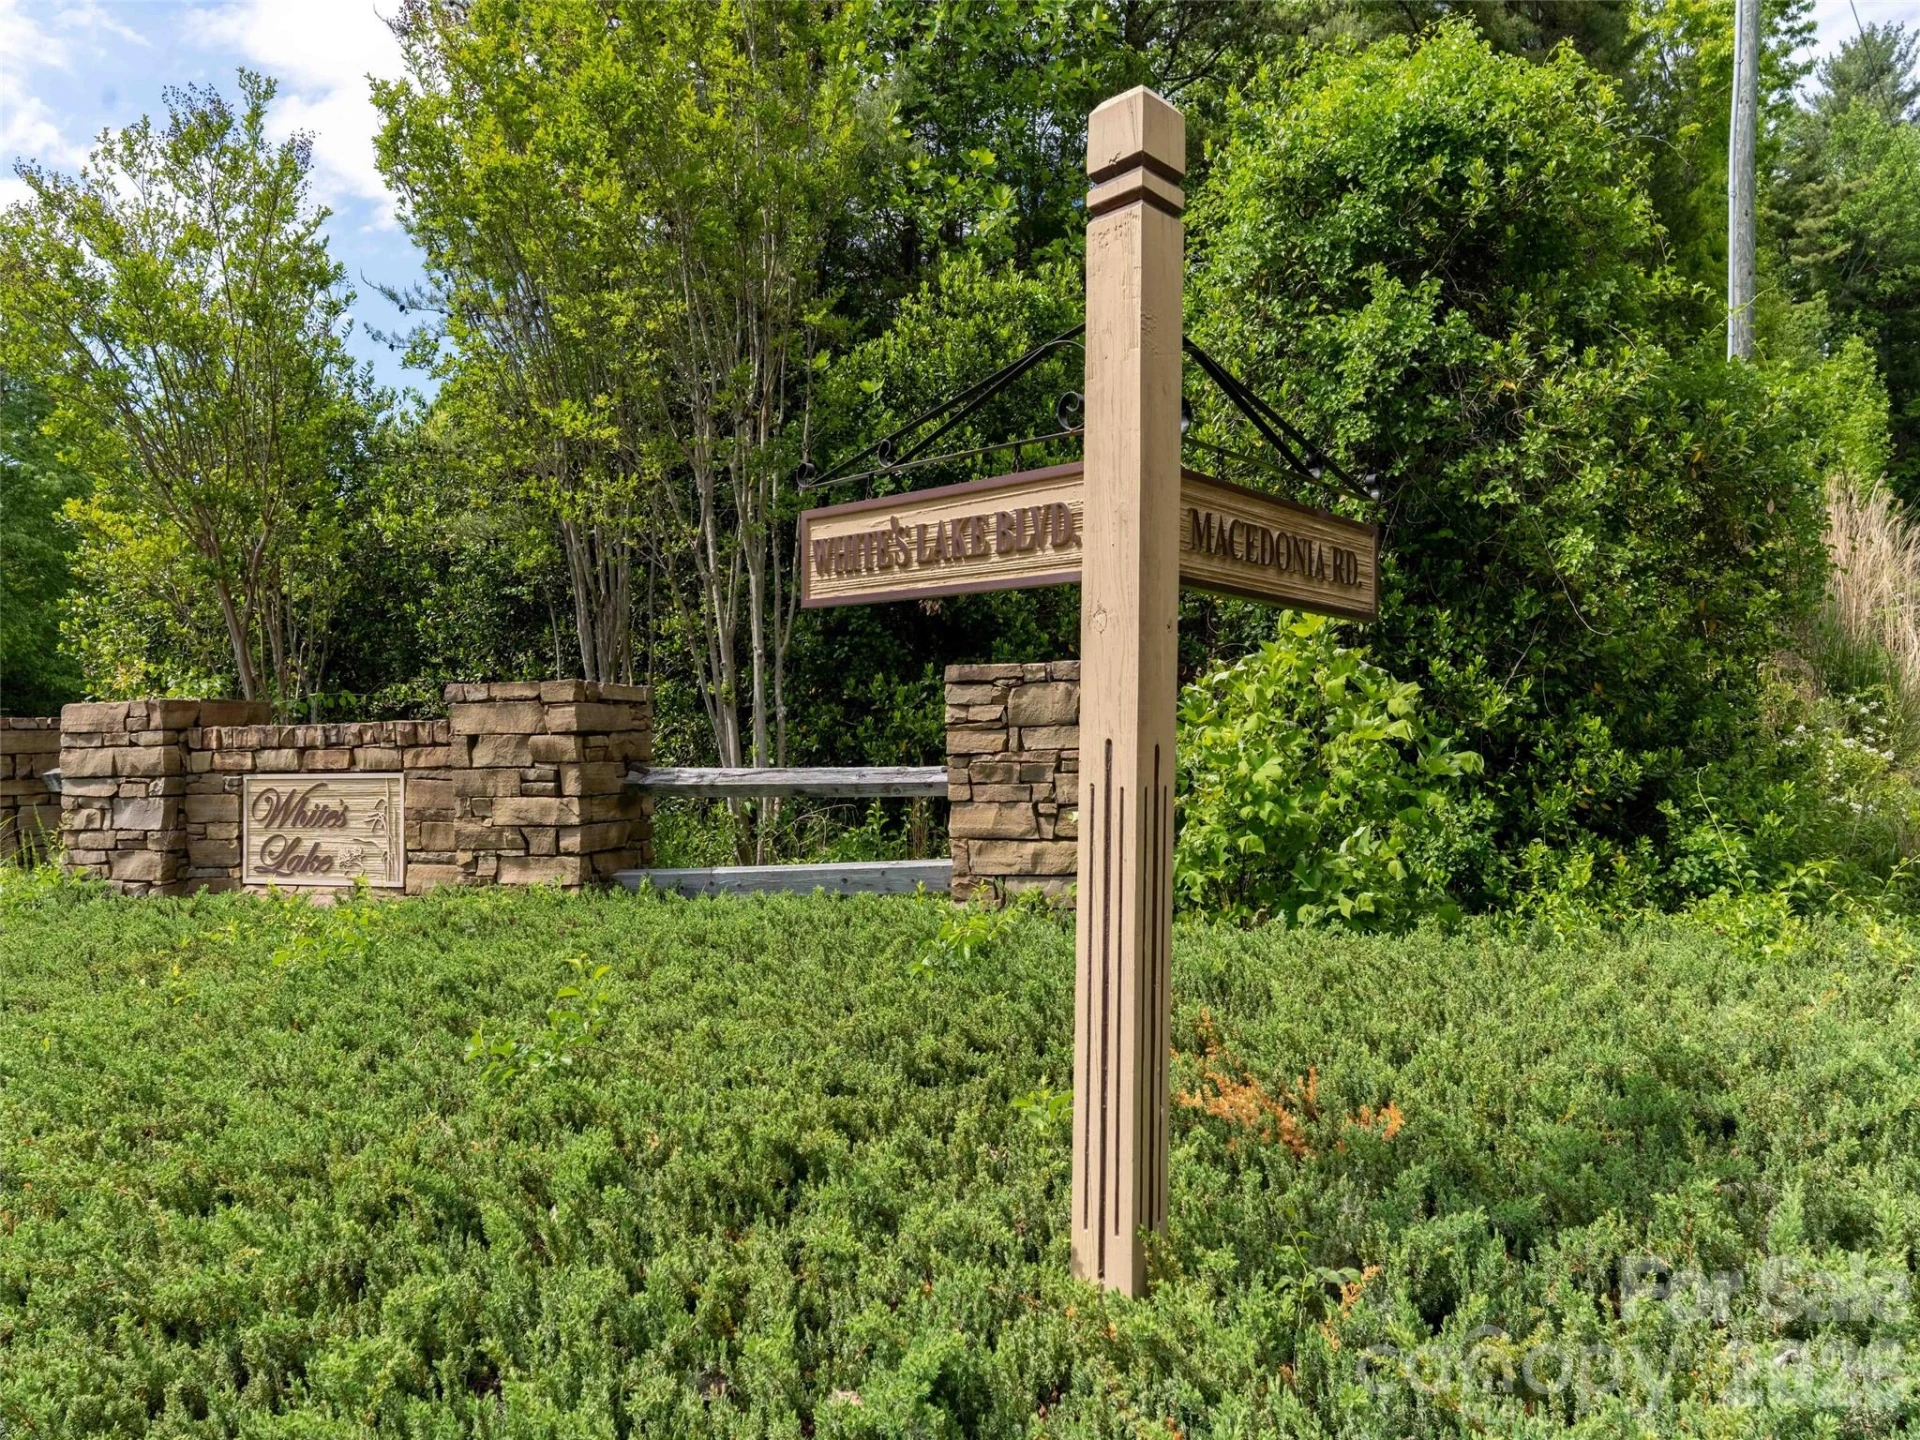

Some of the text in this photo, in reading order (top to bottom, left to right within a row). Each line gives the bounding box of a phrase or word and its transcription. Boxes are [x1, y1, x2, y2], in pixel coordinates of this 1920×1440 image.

[915, 520, 991, 563] LAKE
[995, 502, 1083, 553] BLVD.
[1187, 508, 1326, 582] MACEDONIA
[252, 783, 349, 829] White's
[254, 834, 335, 877] Lake
